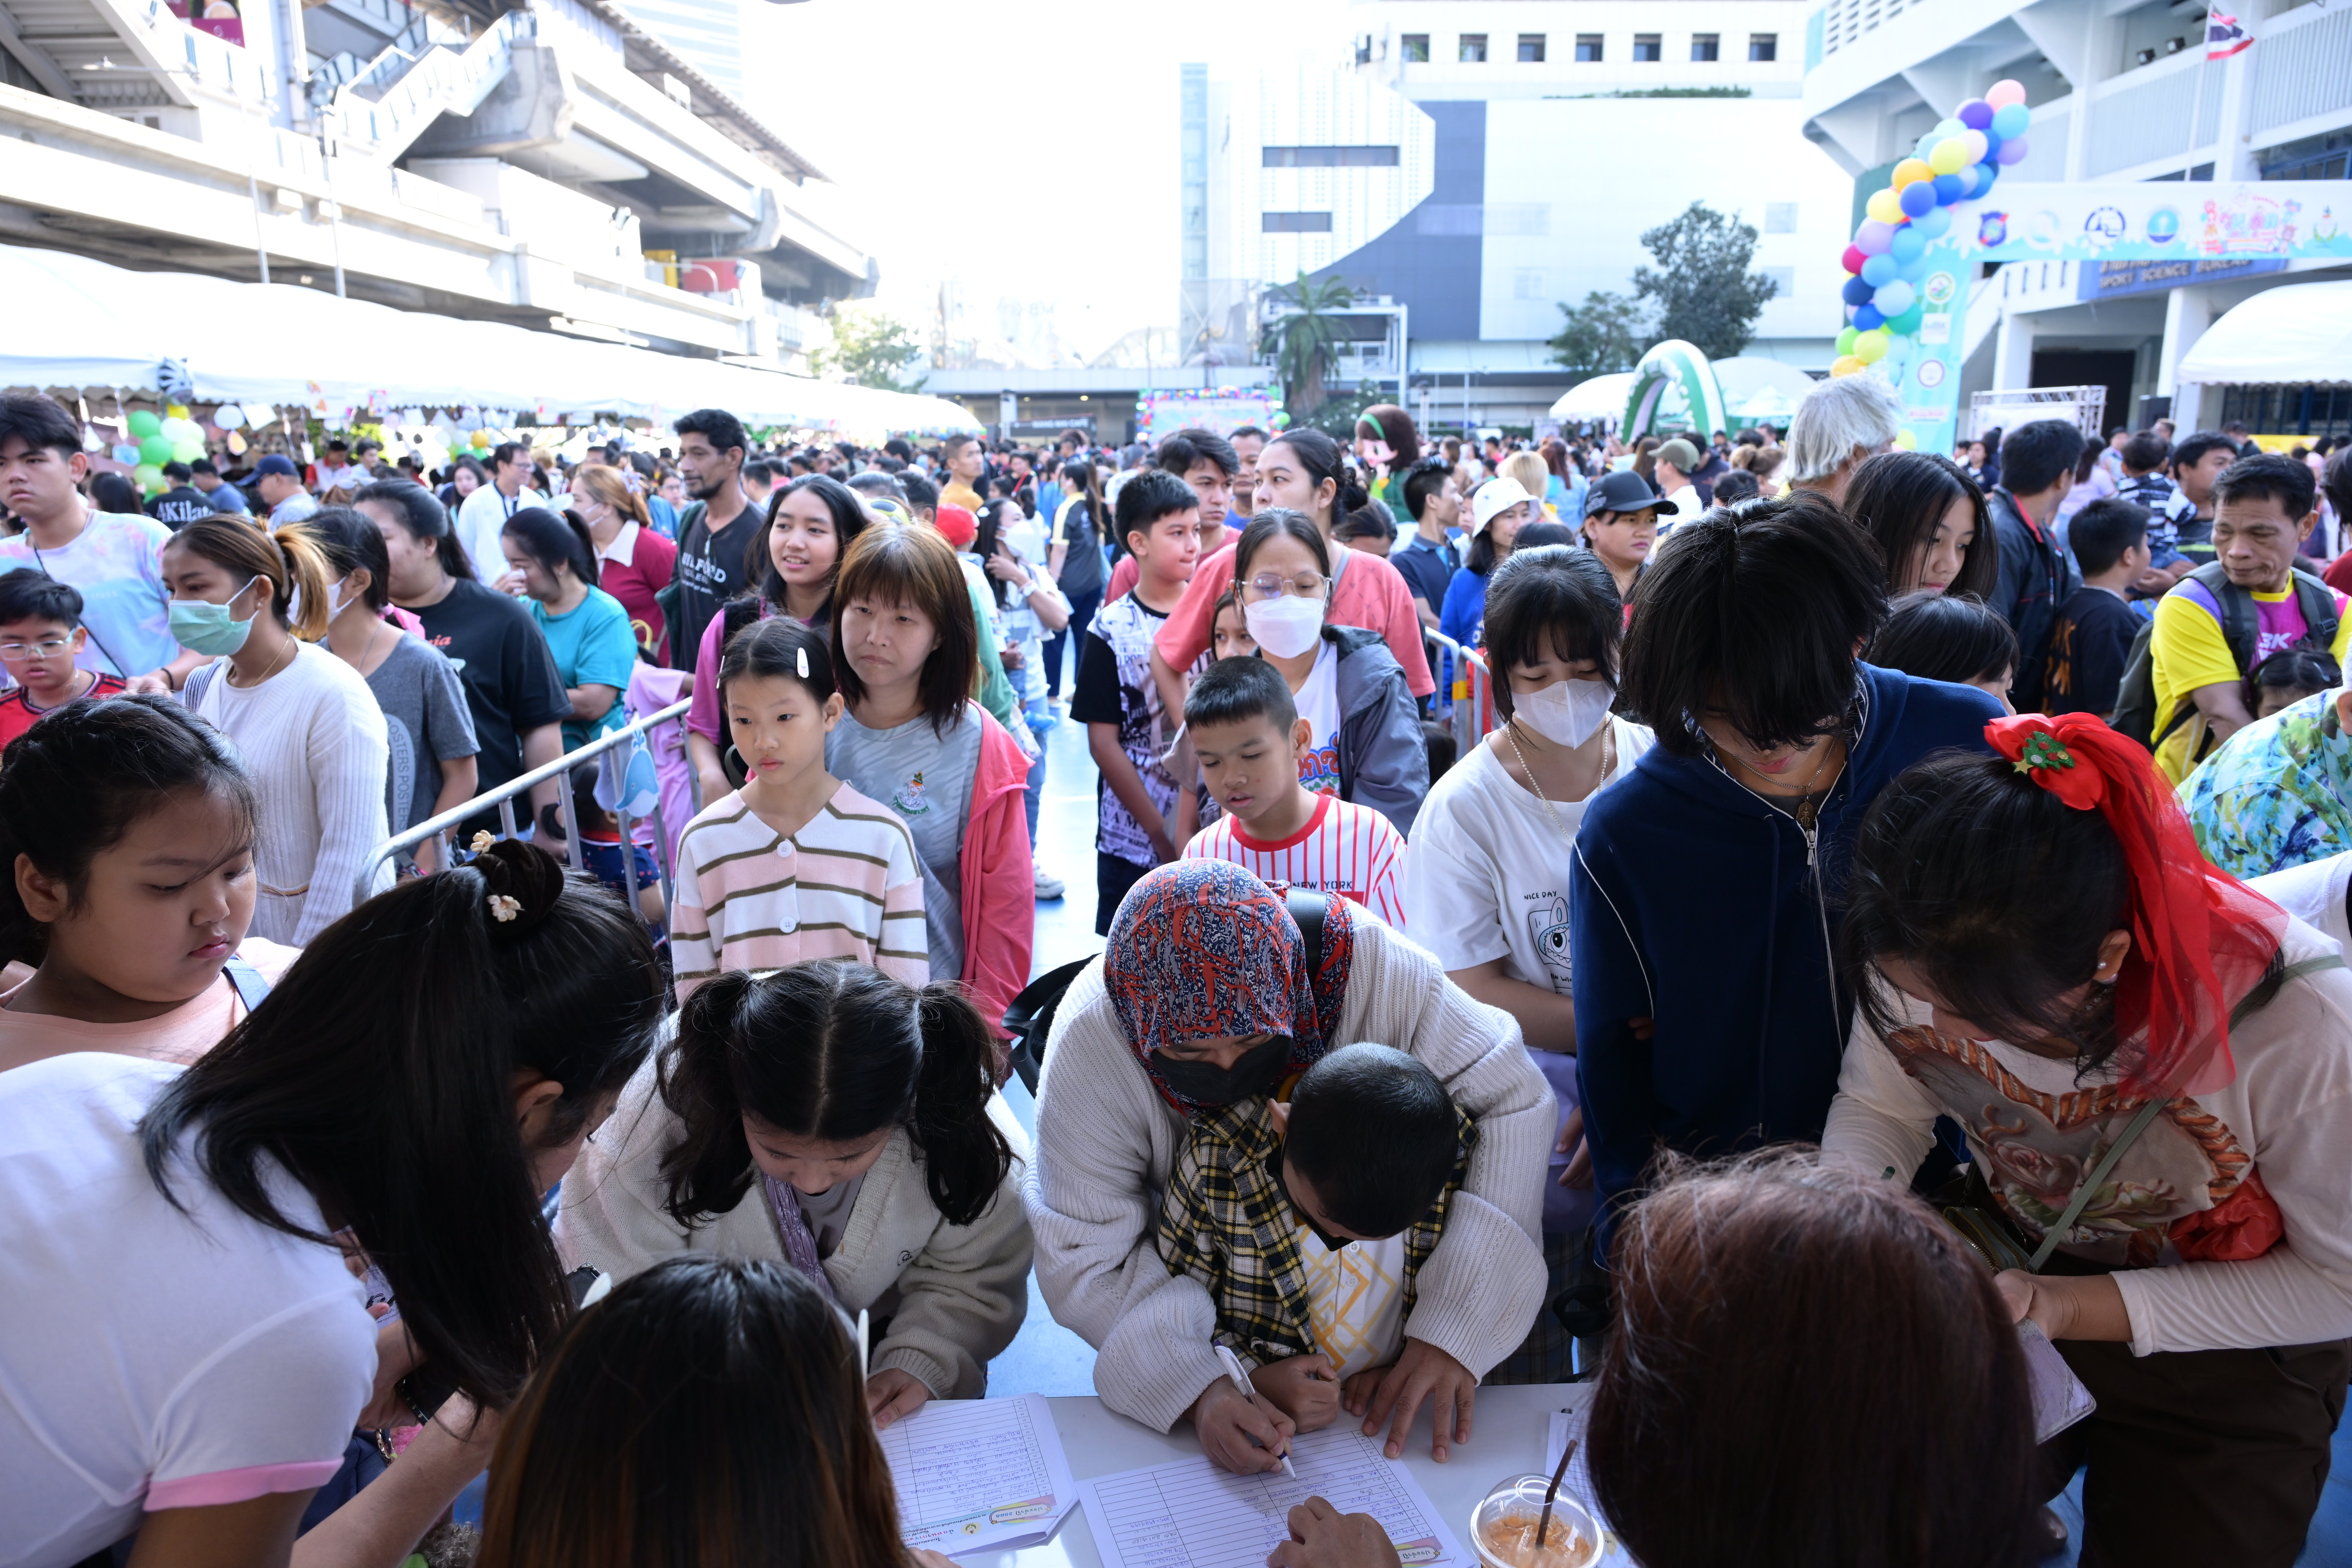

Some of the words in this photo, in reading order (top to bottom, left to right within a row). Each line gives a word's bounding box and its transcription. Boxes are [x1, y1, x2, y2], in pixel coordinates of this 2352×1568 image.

[1015, 1507, 1043, 1516] ประจำปี
[1403, 1550, 1431, 1559] ประจำปี
